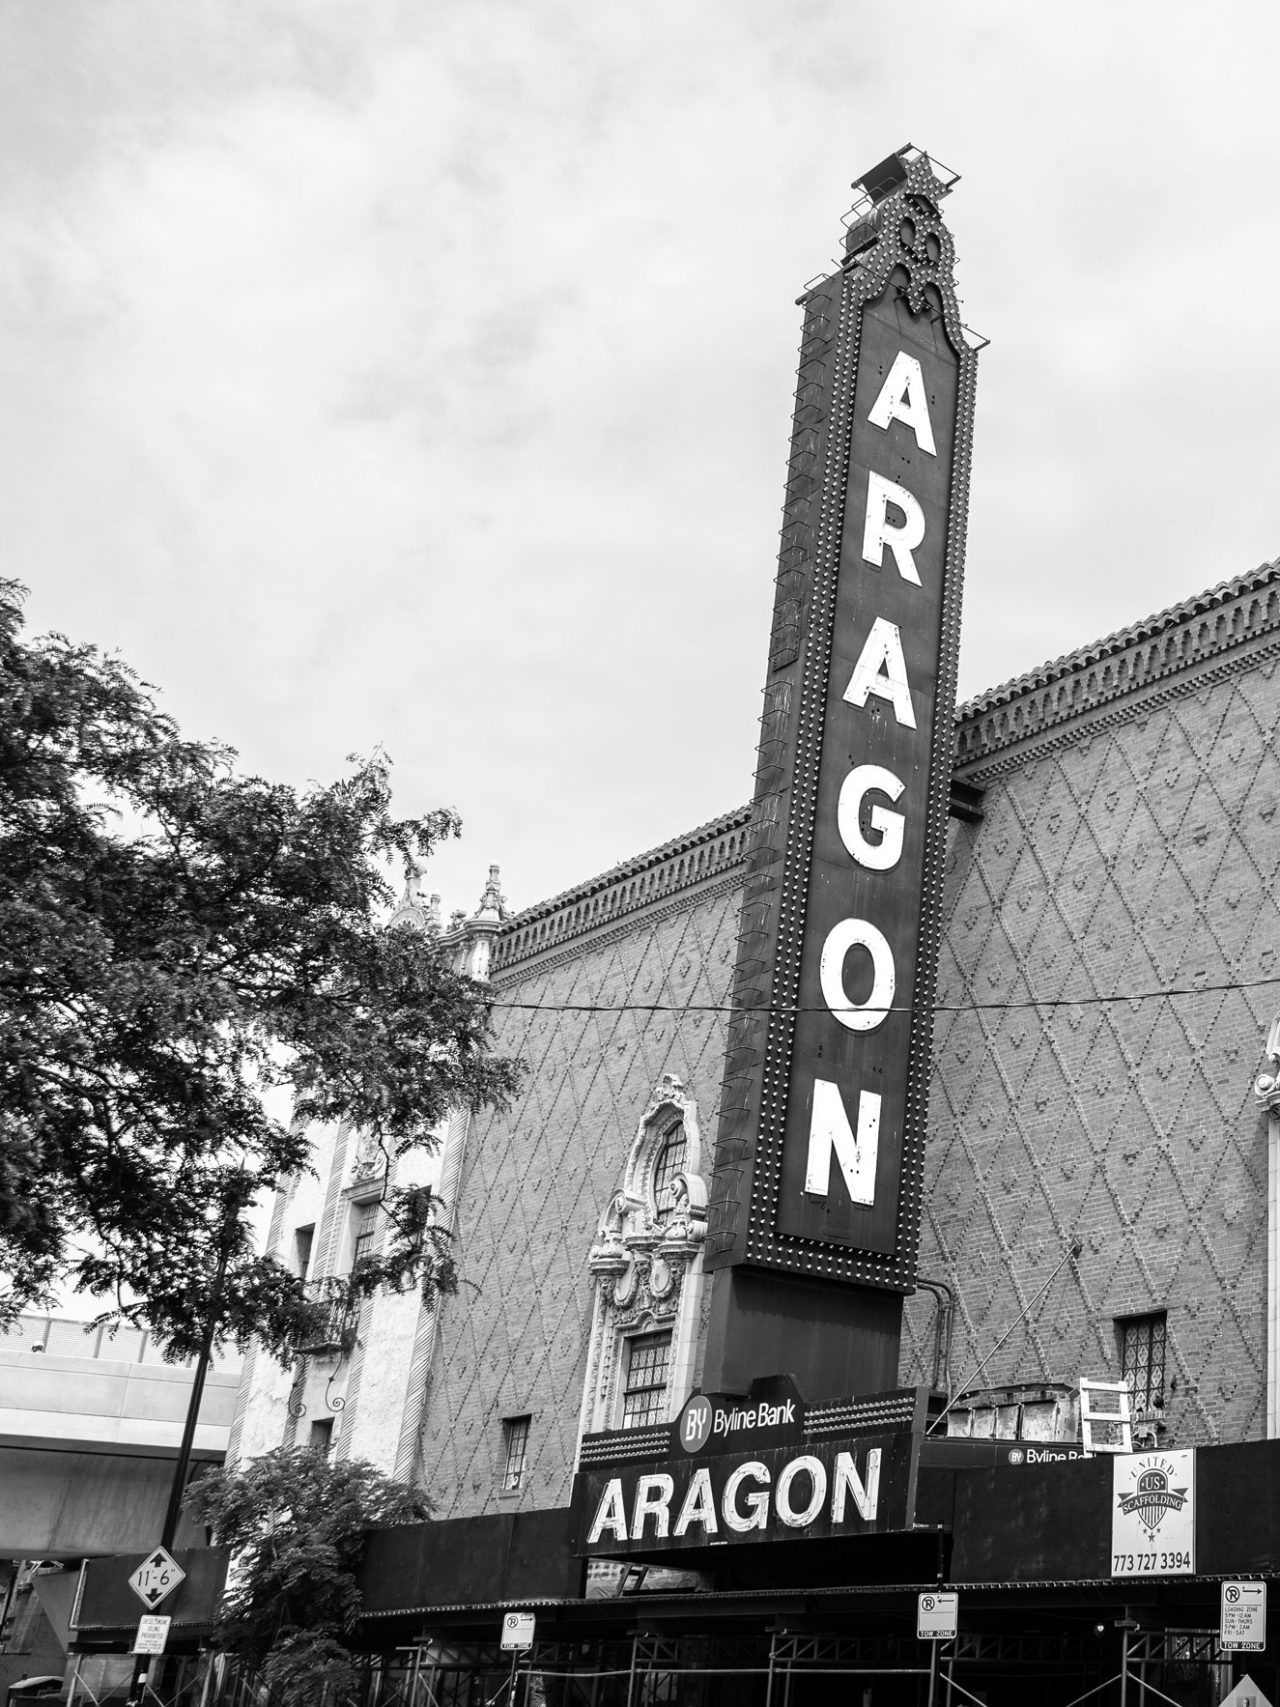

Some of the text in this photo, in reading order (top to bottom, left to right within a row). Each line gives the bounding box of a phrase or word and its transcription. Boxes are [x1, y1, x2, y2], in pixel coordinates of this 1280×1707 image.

[804, 350, 937, 1207] ARAGON
[685, 1398, 796, 1441] BY Byline Bank
[1011, 1452, 1022, 1462] BY
[1130, 1456, 1176, 1478] UNITED
[1145, 1476, 1160, 1490] US
[587, 1448, 882, 1543] ARAGON
[1123, 1494, 1182, 1513] SCAFFOLDING
[1114, 1551, 1191, 1572] 773 727 3394
[1241, 1642, 1261, 1650] ZONE
